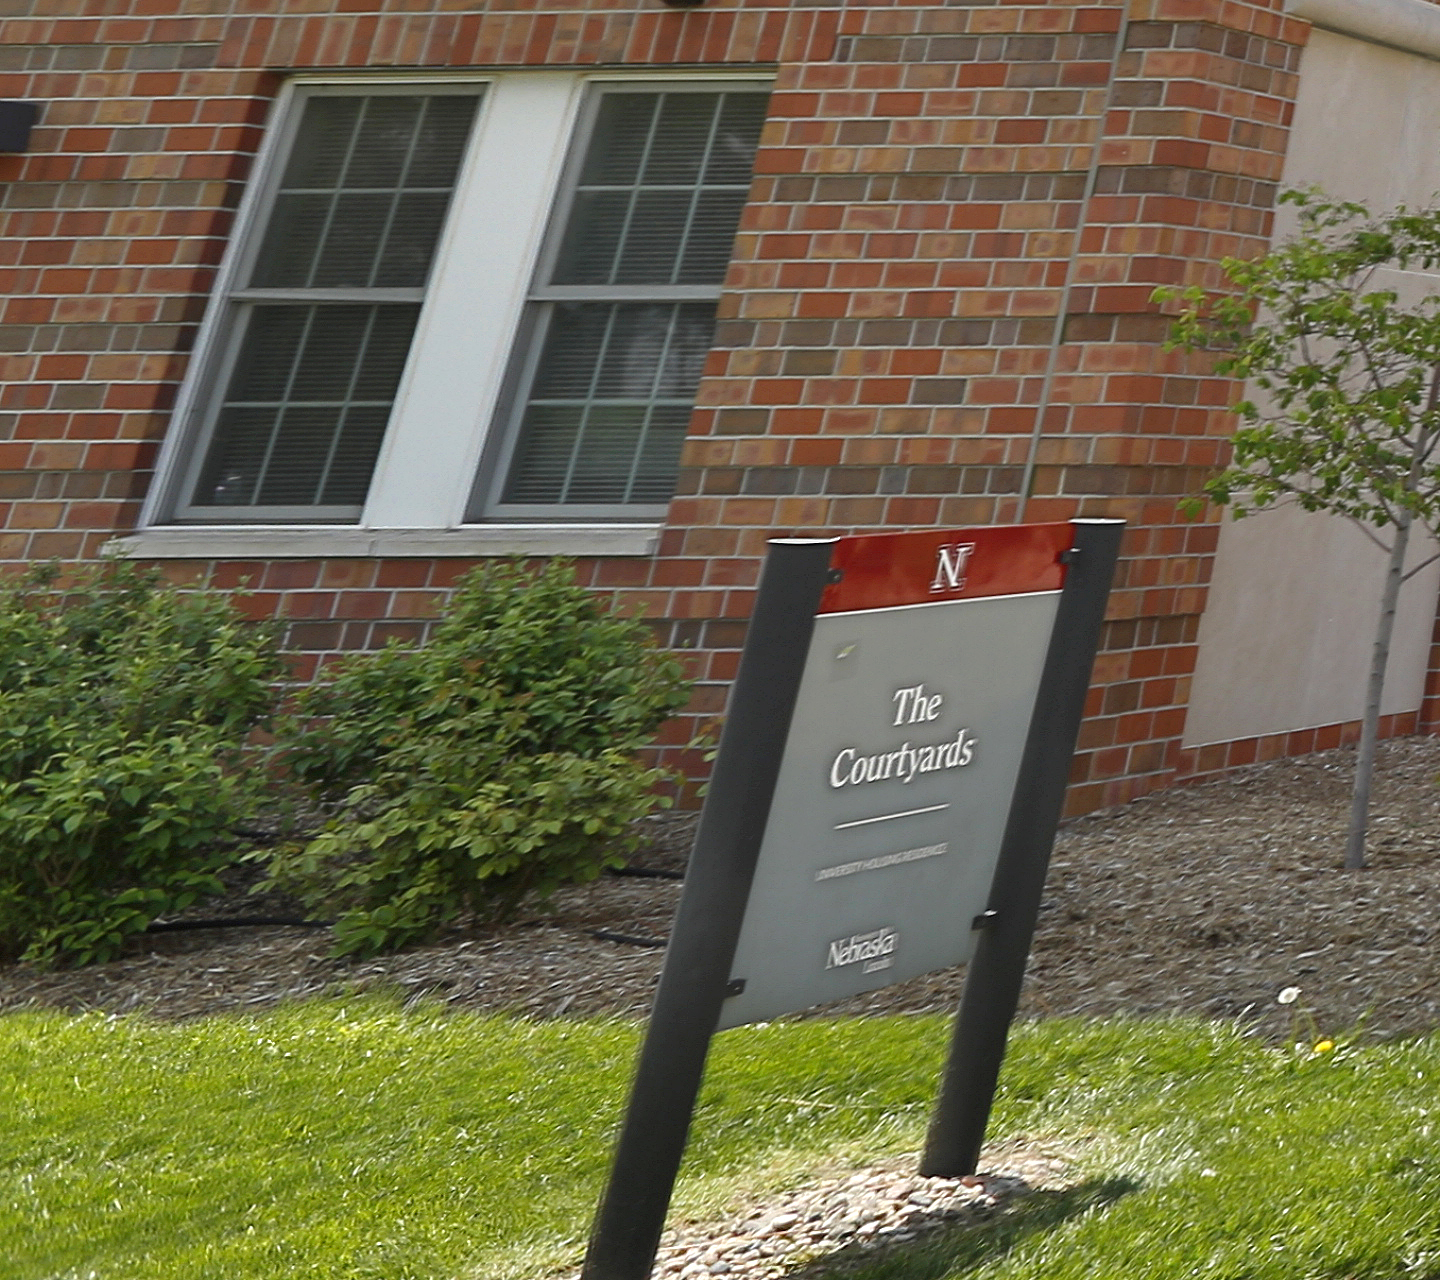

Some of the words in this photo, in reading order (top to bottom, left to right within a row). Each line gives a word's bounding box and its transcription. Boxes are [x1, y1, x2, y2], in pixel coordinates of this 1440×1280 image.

[929, 542, 976, 593] N
[892, 683, 943, 726] The
[830, 728, 978, 788] Courtyards
[825, 929, 899, 971] Nebraska
